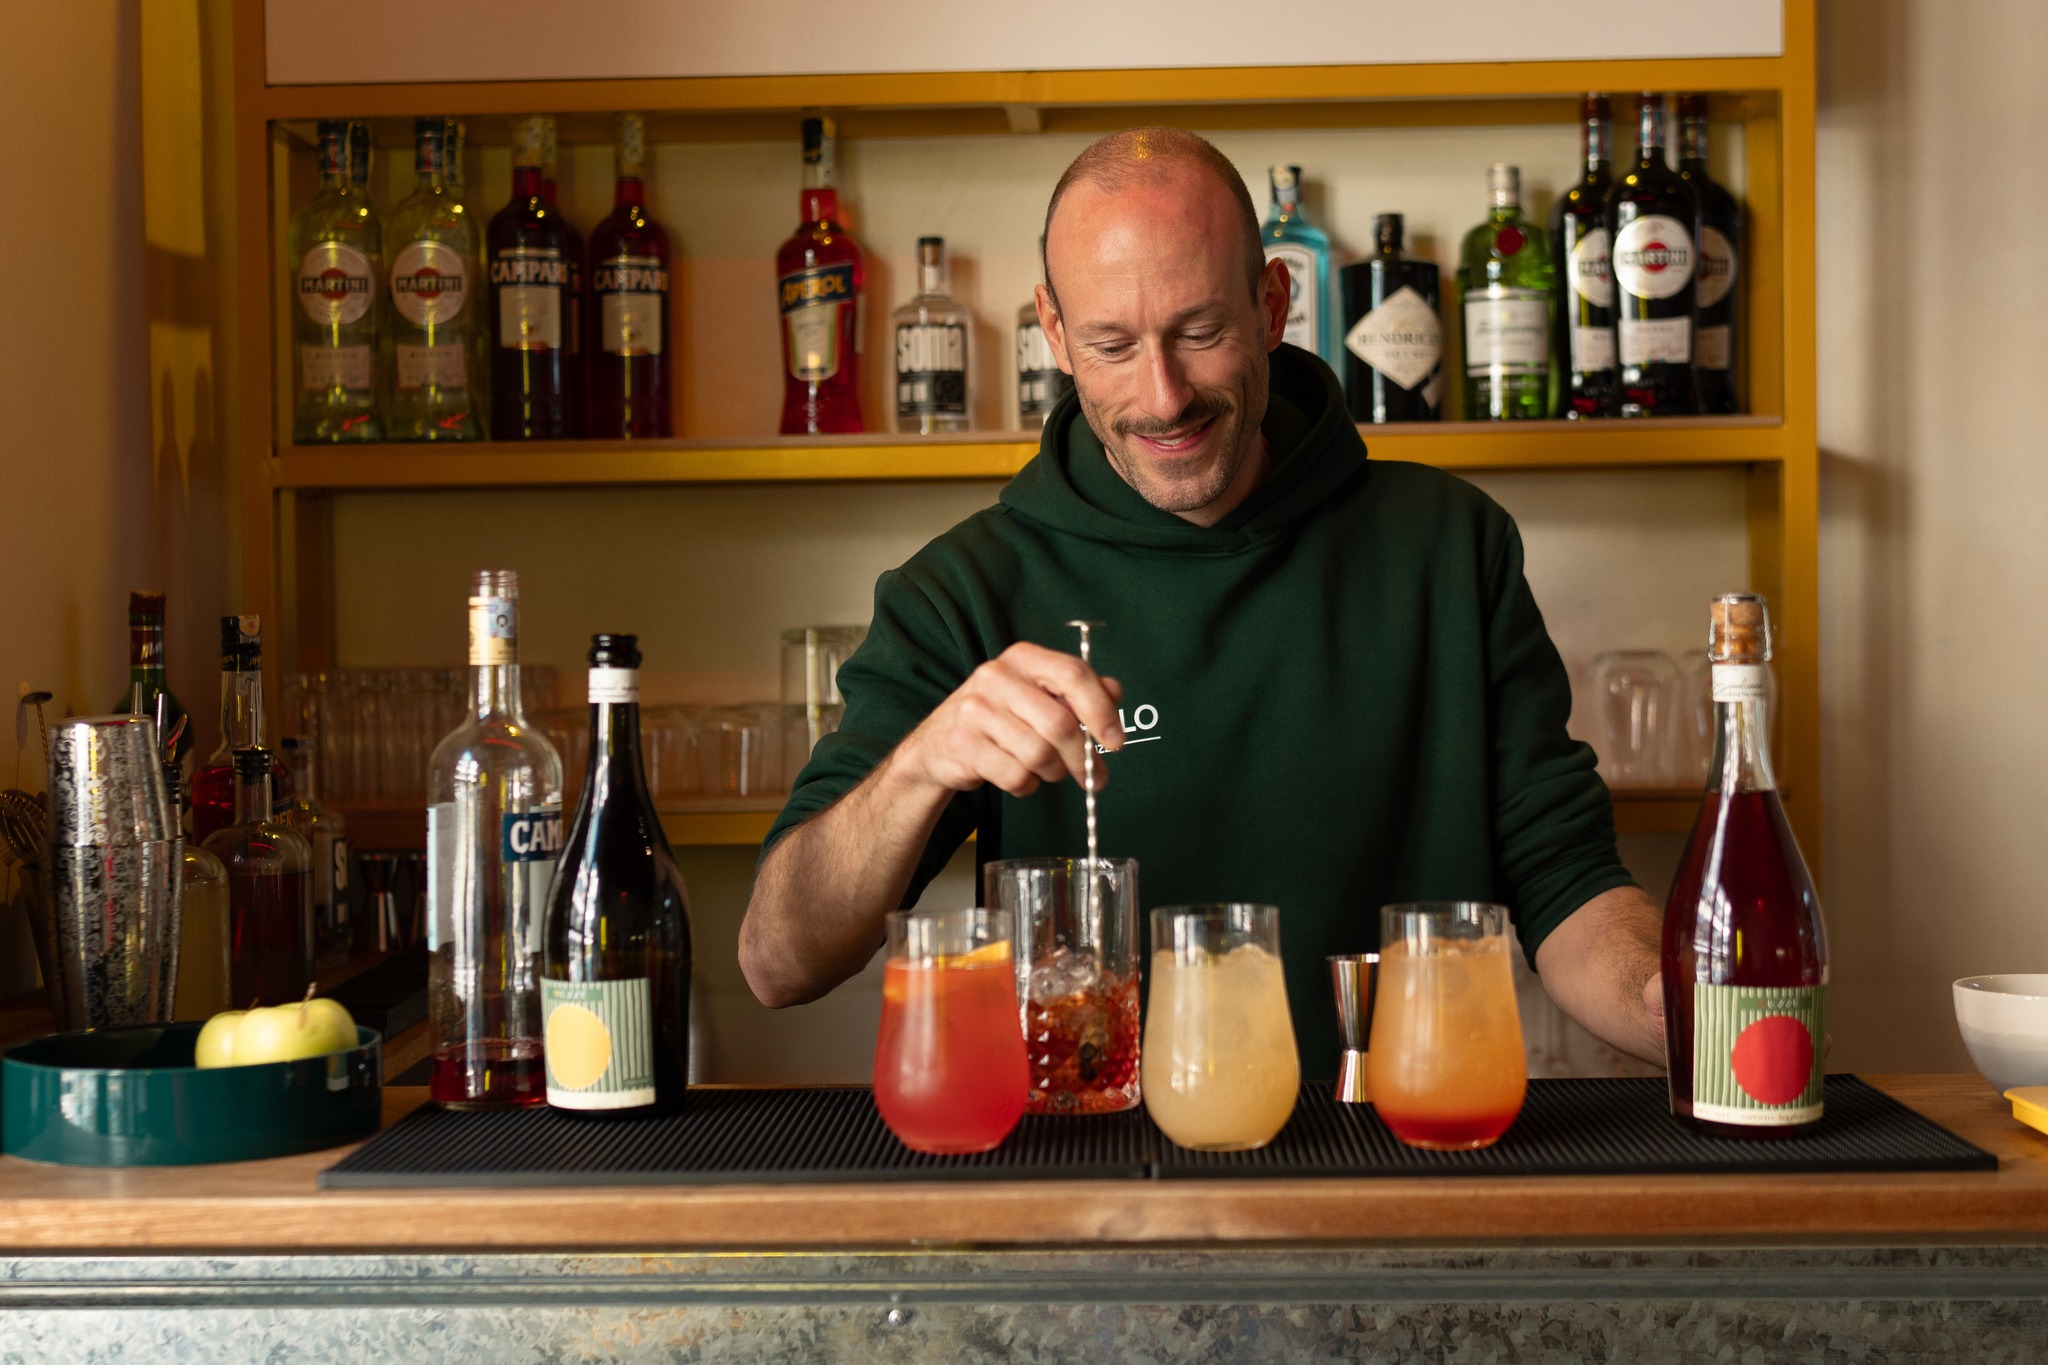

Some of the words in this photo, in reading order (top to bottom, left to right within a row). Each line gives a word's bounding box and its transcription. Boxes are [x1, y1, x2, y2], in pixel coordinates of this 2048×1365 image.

[1621, 251, 1689, 267] MARTINI
[491, 261, 569, 285] CAMPARI
[302, 277, 368, 292] MARTINI
[397, 276, 462, 292] MARTINI
[782, 274, 846, 306] APEROL
